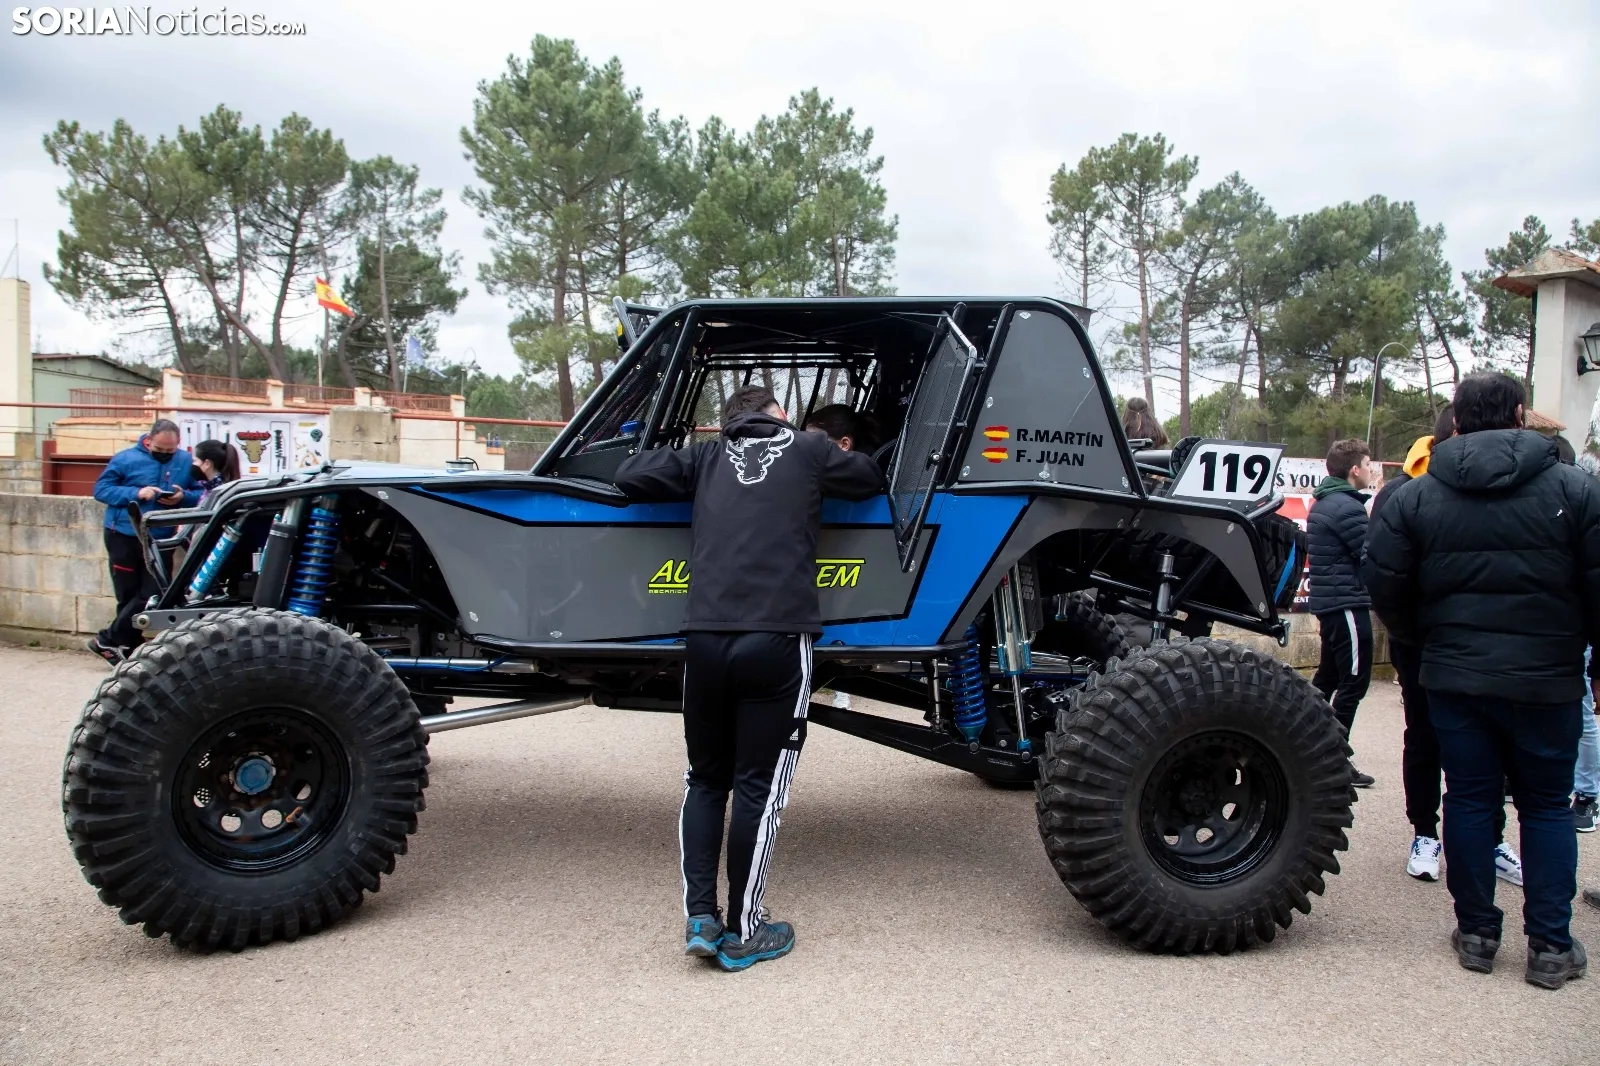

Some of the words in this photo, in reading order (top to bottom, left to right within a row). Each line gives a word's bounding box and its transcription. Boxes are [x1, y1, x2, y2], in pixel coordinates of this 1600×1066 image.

[1016, 428, 1103, 447] R.MARTÍN
[1015, 449, 1031, 463] F.
[1035, 450, 1084, 466] JUAN
[1200, 451, 1271, 494] 119
[650, 559, 690, 583] AU
[816, 565, 861, 588] EM
